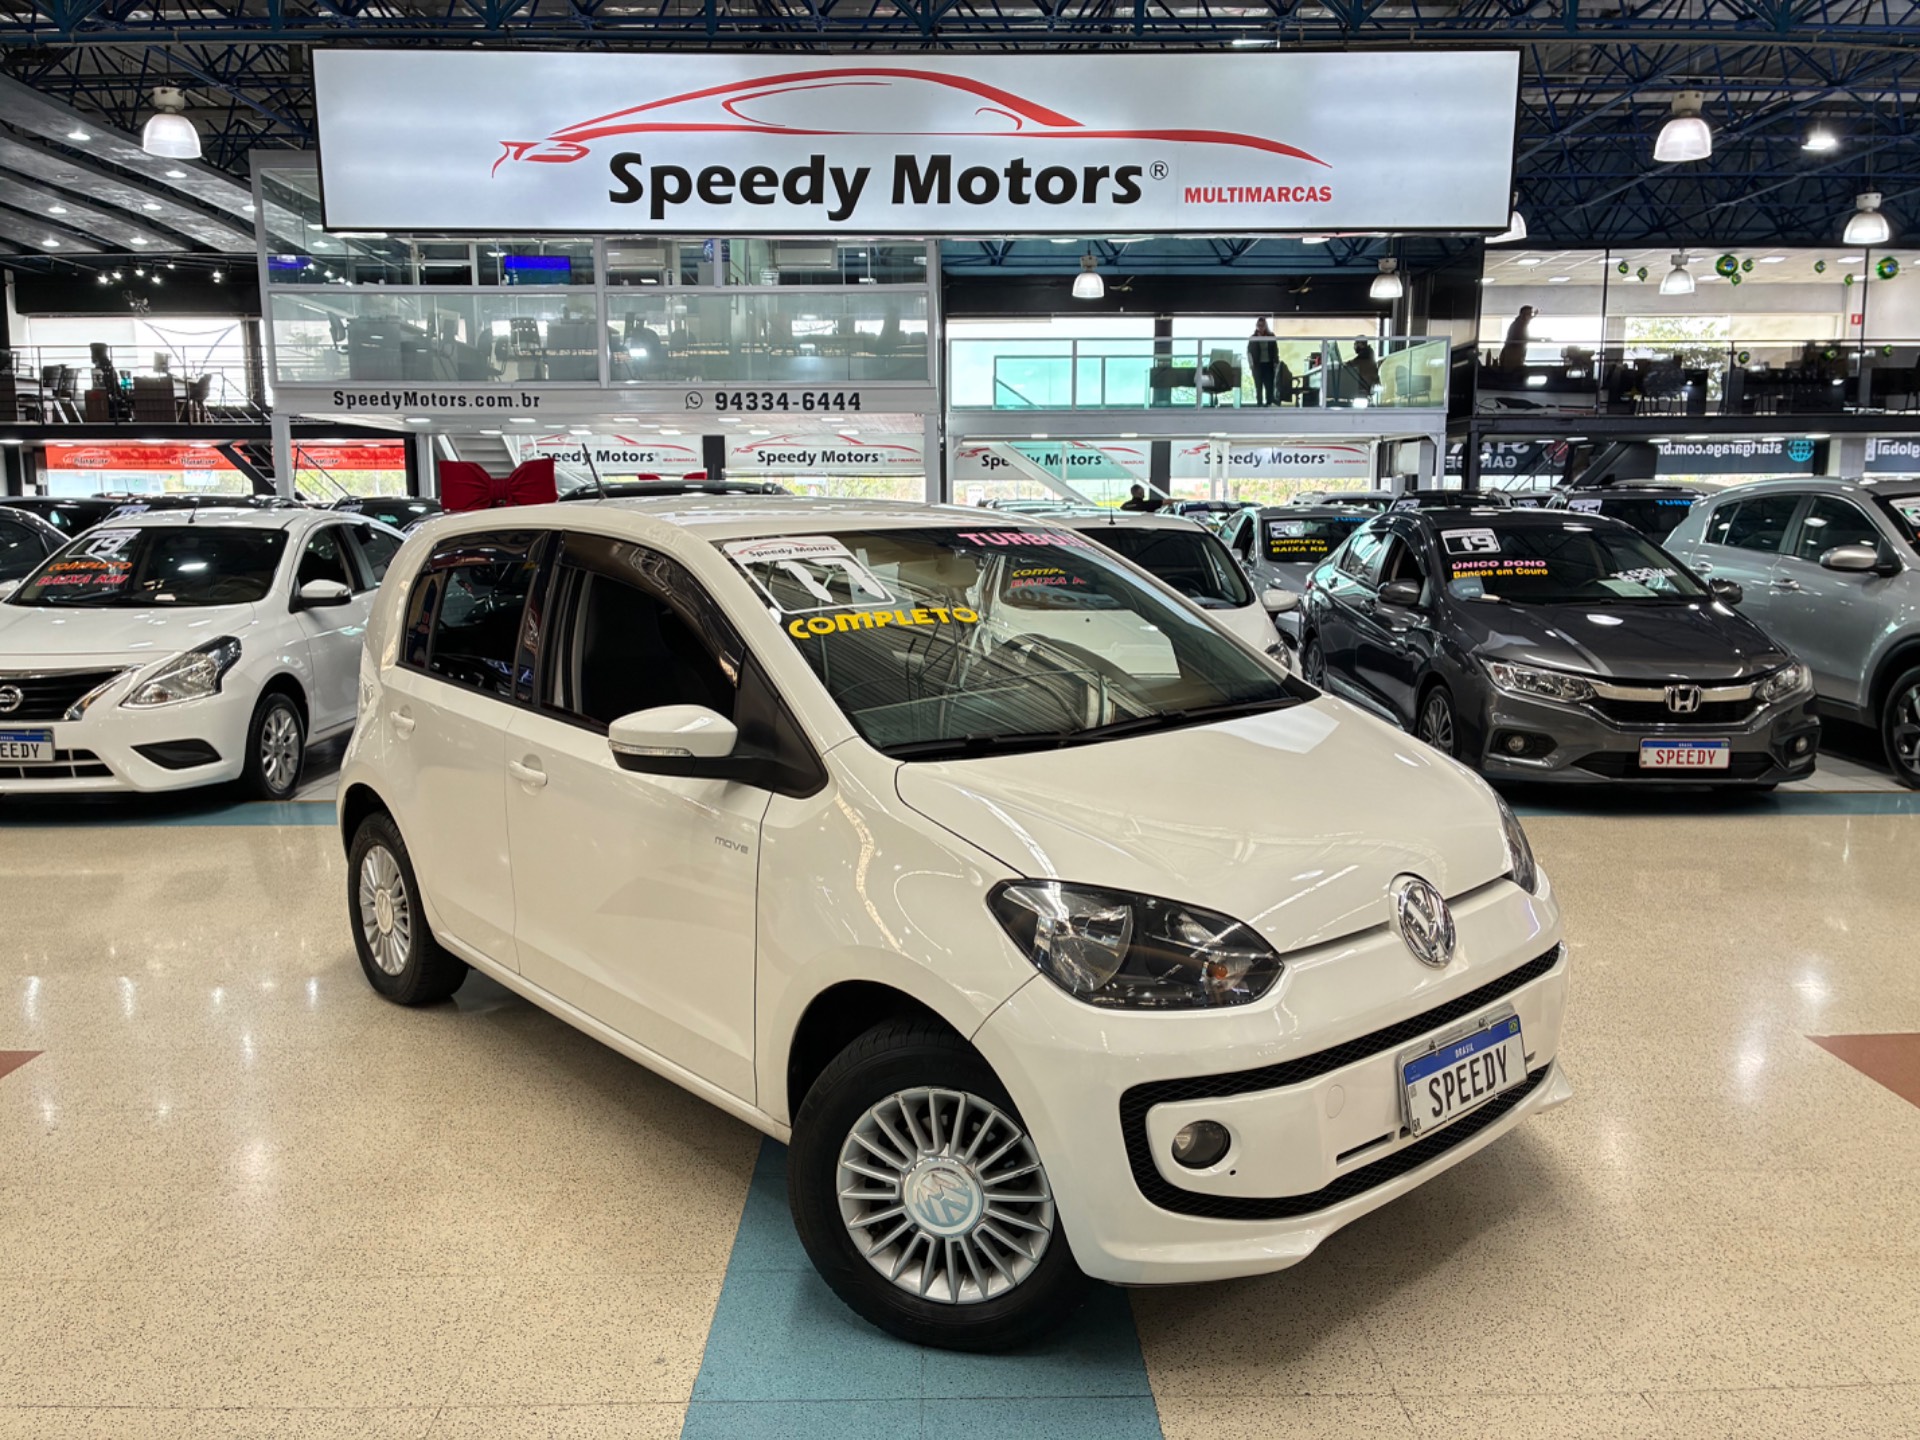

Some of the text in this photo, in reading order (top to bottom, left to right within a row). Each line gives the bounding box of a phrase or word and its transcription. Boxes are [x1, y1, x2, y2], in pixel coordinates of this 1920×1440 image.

[609, 152, 871, 221] Speedy
[1184, 186, 1332, 203] MULTIMARCAS
[333, 391, 540, 409] SpeedyMotors.com.br
[715, 392, 861, 411] 94334-6444
[757, 450, 879, 466] Speedy Motors
[1461, 535, 1496, 551] 19
[748, 547, 793, 557] Speedy
[48, 561, 133, 571] COMPLETO
[1452, 560, 1546, 570] ÚNICO DONO
[35, 574, 130, 586] BAIXA KM
[1453, 569, 1494, 579] Bancos
[1515, 568, 1549, 576] Couro
[1010, 576, 1067, 588] BAIXA
[788, 607, 979, 639] COMPLETO
[1655, 749, 1717, 765] SPEEDY
[714, 836, 749, 855] move
[1454, 1043, 1475, 1059] BRASIL
[1428, 1044, 1508, 1118] SPEEDY
